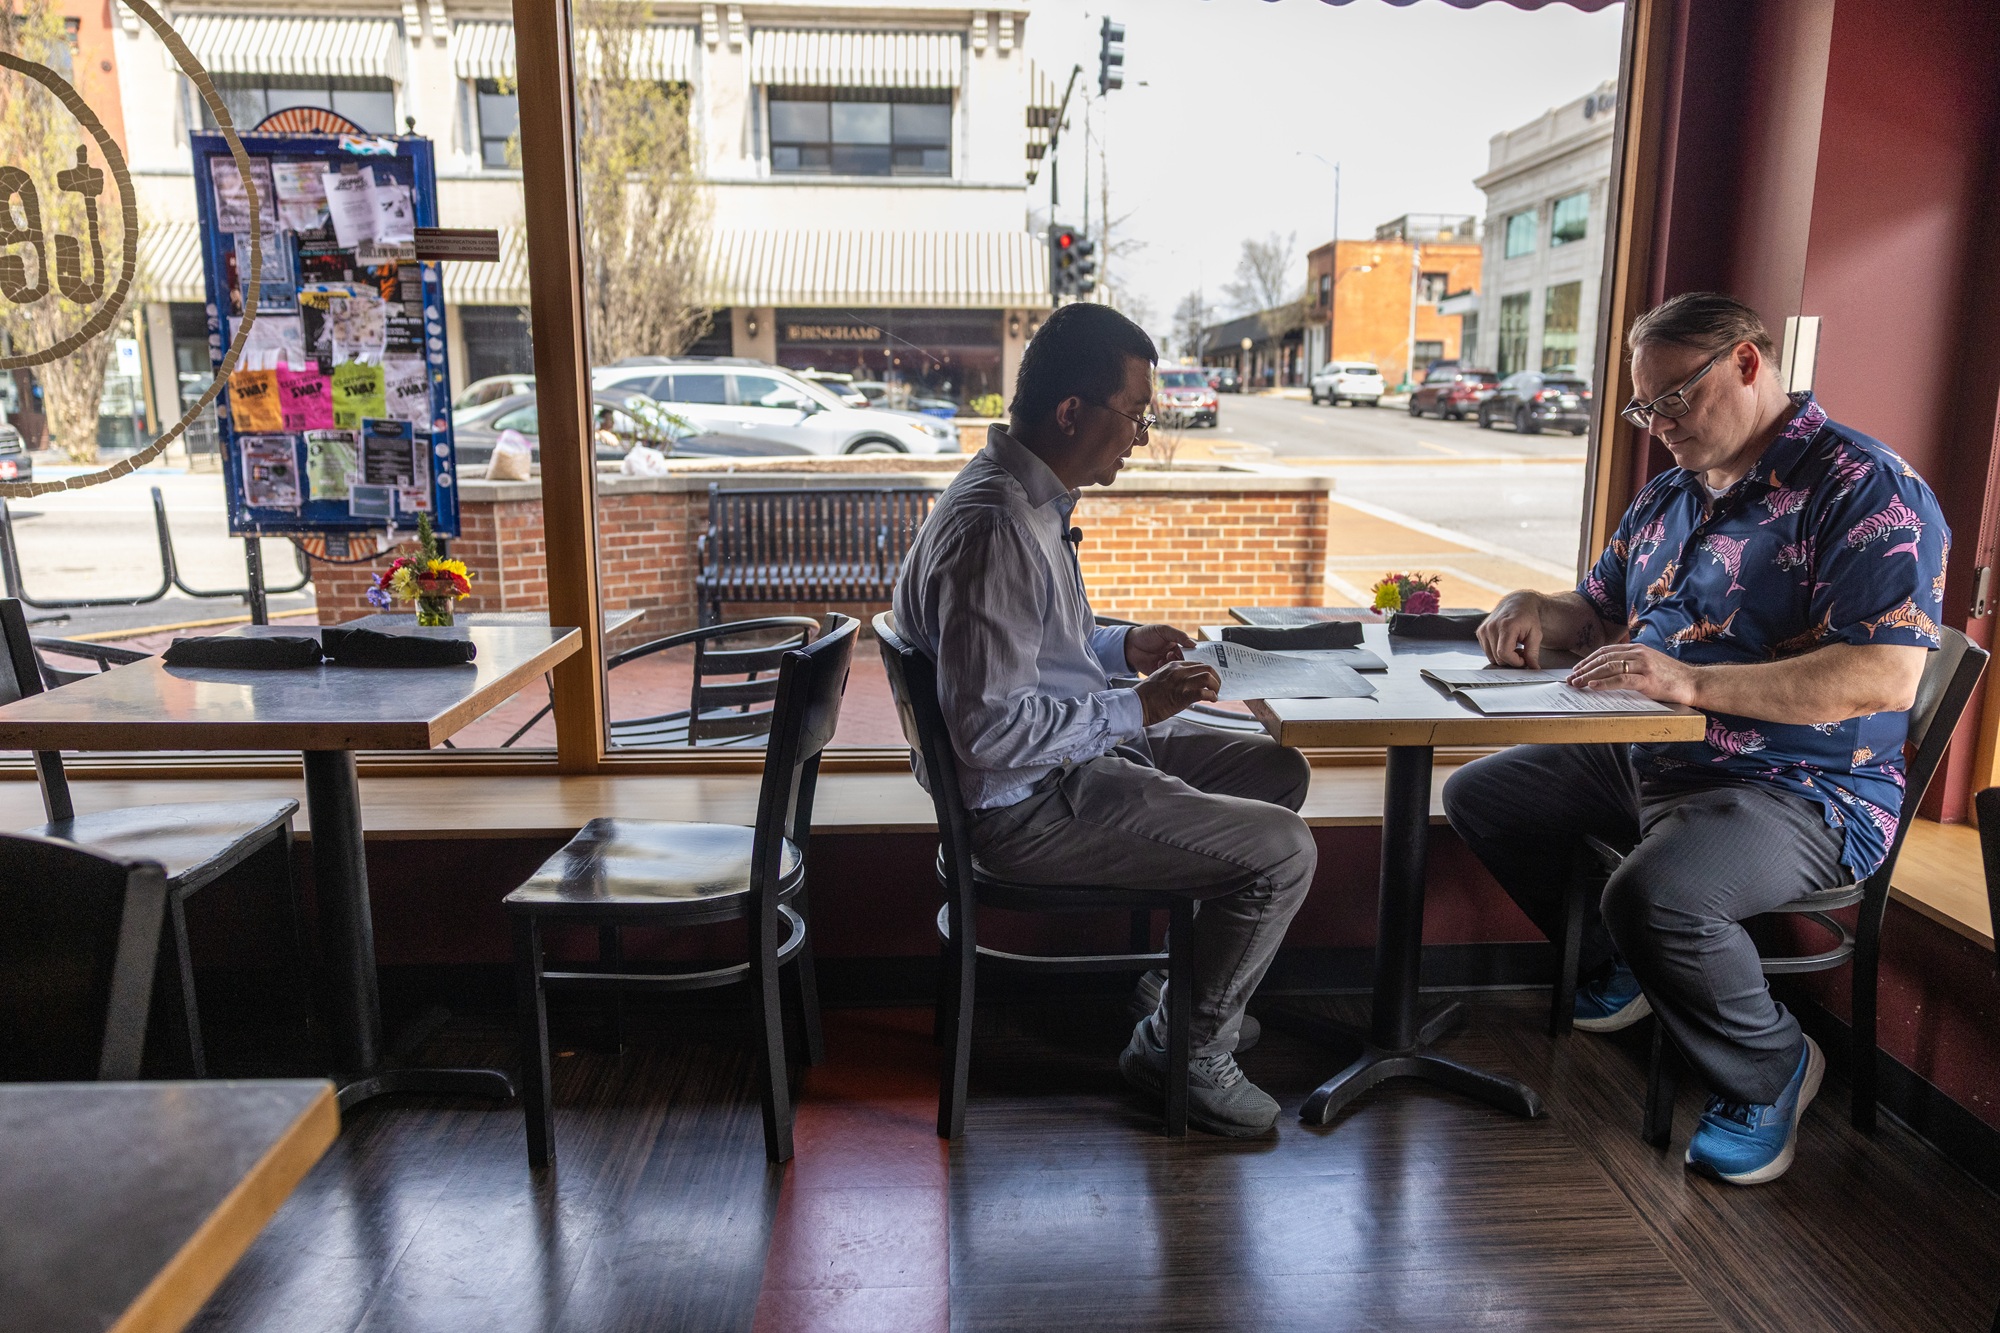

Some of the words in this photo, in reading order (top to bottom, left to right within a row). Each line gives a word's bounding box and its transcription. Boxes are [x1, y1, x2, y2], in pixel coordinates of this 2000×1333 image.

[237, 382, 268, 399] SWAP
[291, 382, 323, 398] SWAP
[343, 382, 376, 397] SWAP
[396, 382, 428, 398] SWAP
